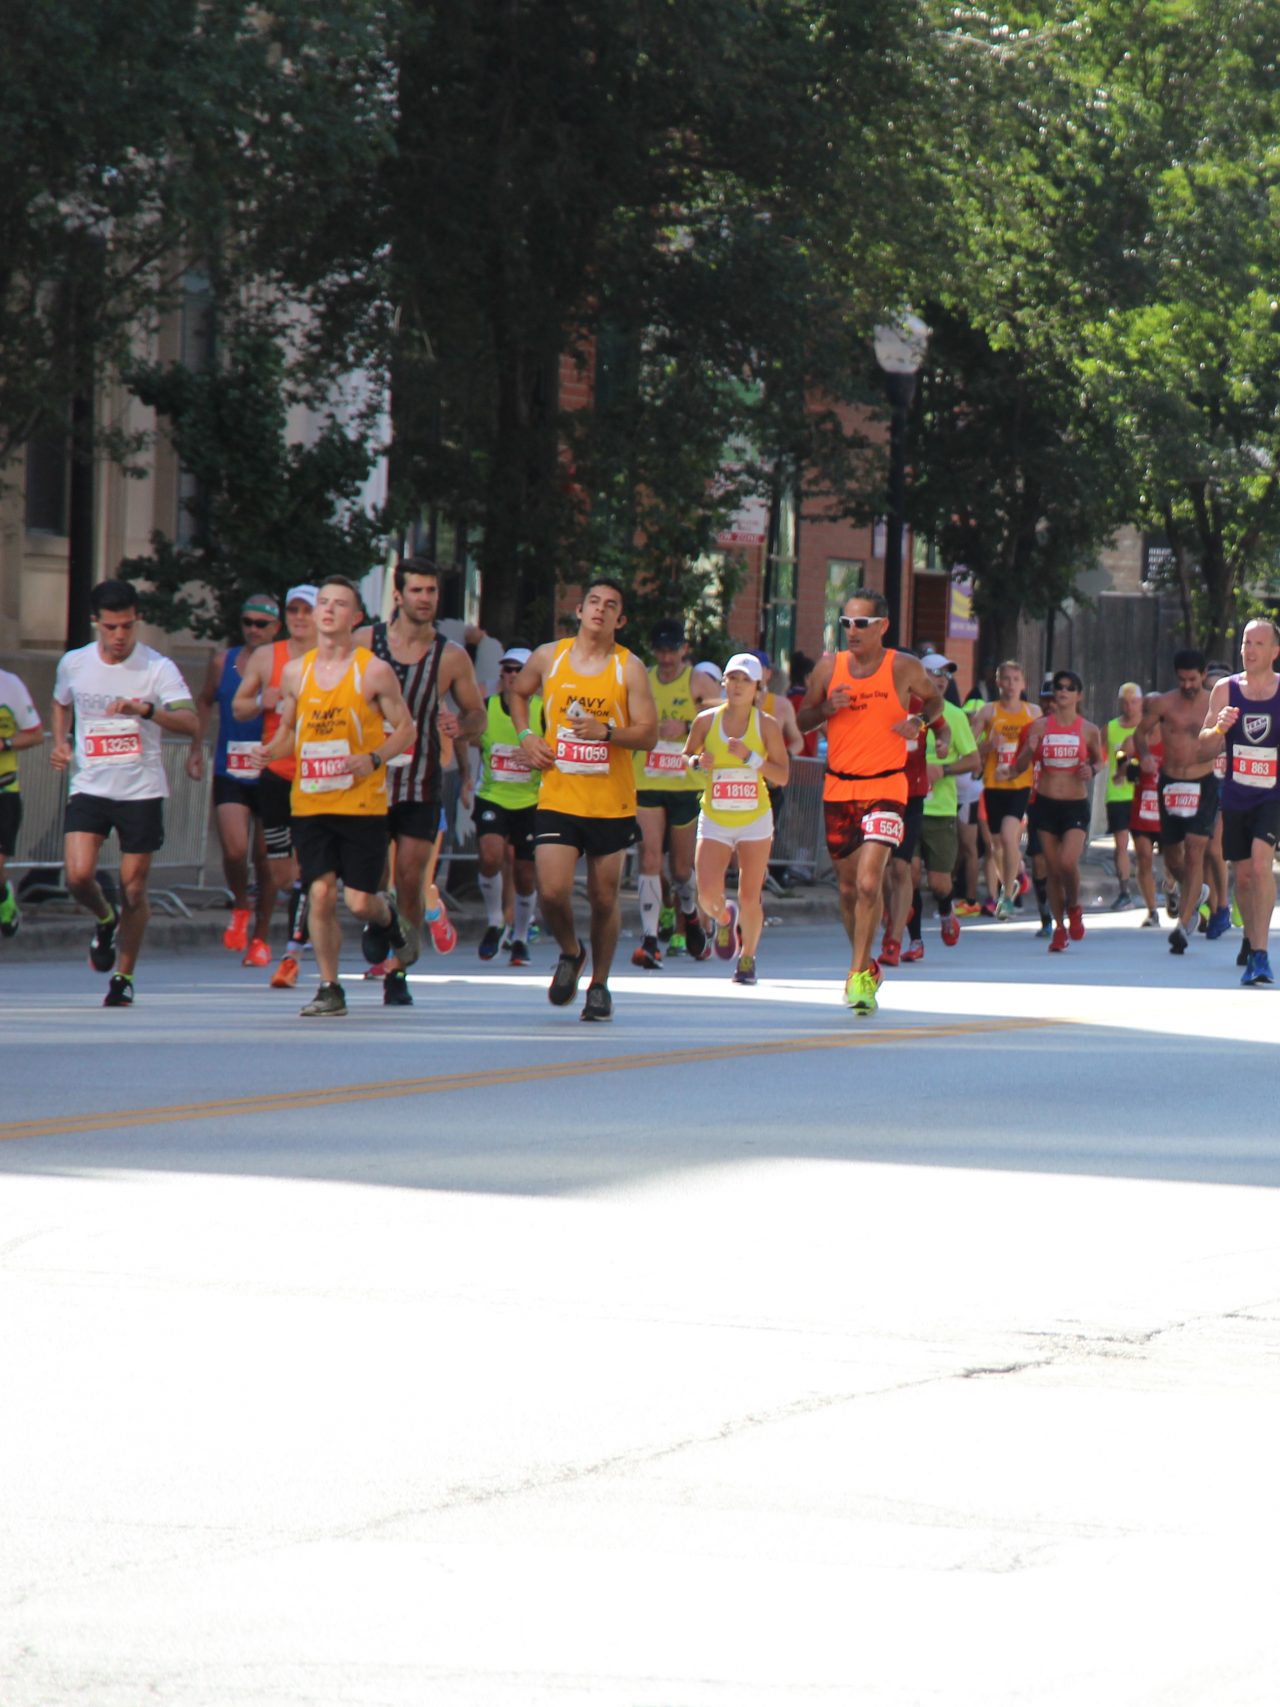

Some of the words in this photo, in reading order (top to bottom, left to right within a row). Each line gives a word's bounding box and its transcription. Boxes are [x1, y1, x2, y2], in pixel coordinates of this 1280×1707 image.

[86, 740, 94, 754] D
[558, 743, 566, 757] B
[572, 745, 608, 761] 11059
[1239, 758, 1246, 771] B
[1251, 761, 1269, 774] 863
[713, 785, 721, 797] C
[725, 784, 757, 797] 18162
